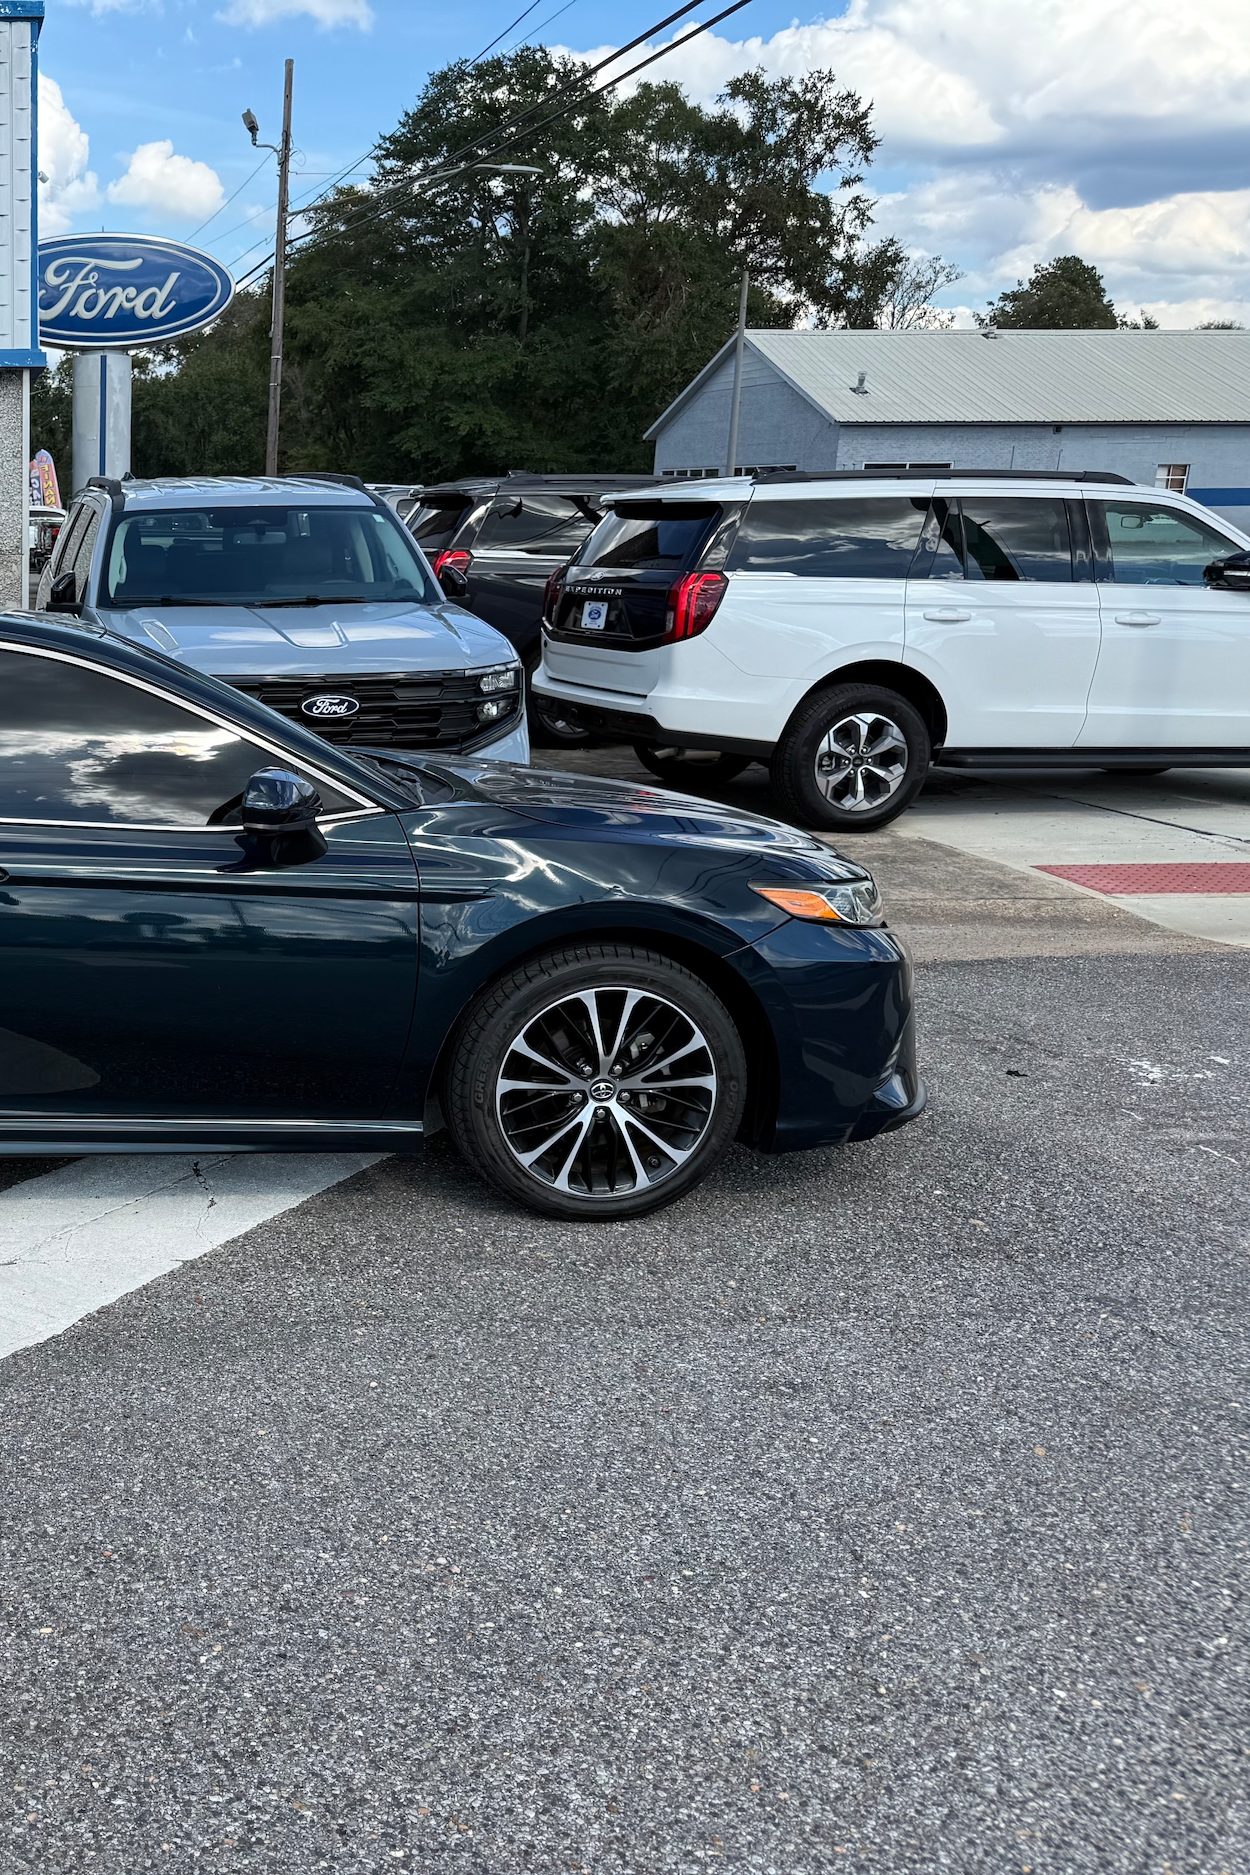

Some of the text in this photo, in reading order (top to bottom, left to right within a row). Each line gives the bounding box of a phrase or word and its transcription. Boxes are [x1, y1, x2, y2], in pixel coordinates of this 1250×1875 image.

[38, 256, 181, 322] Ford
[565, 585, 622, 596] EXPEDITION
[312, 698, 349, 714] Ford
